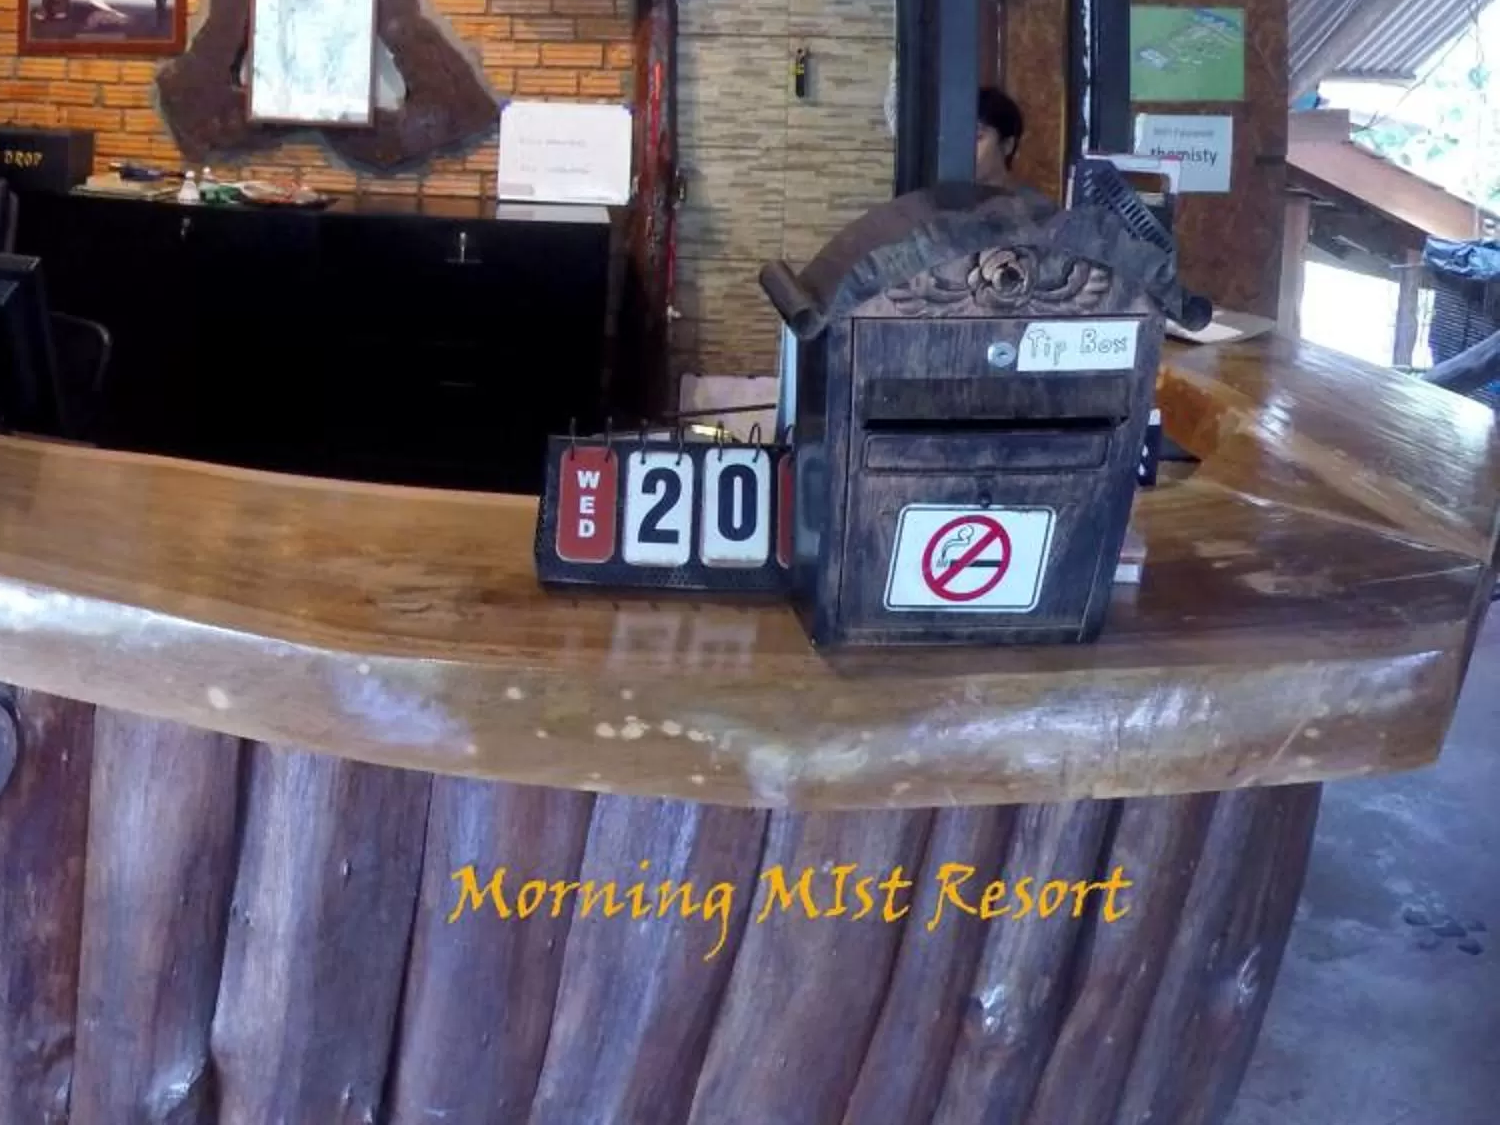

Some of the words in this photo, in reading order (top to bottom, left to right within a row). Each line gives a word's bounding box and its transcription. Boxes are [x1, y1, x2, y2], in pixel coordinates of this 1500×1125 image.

[1027, 328, 1067, 366] Tip
[1078, 328, 1128, 354] Box
[577, 470, 601, 539] WED
[637, 464, 759, 544] 20
